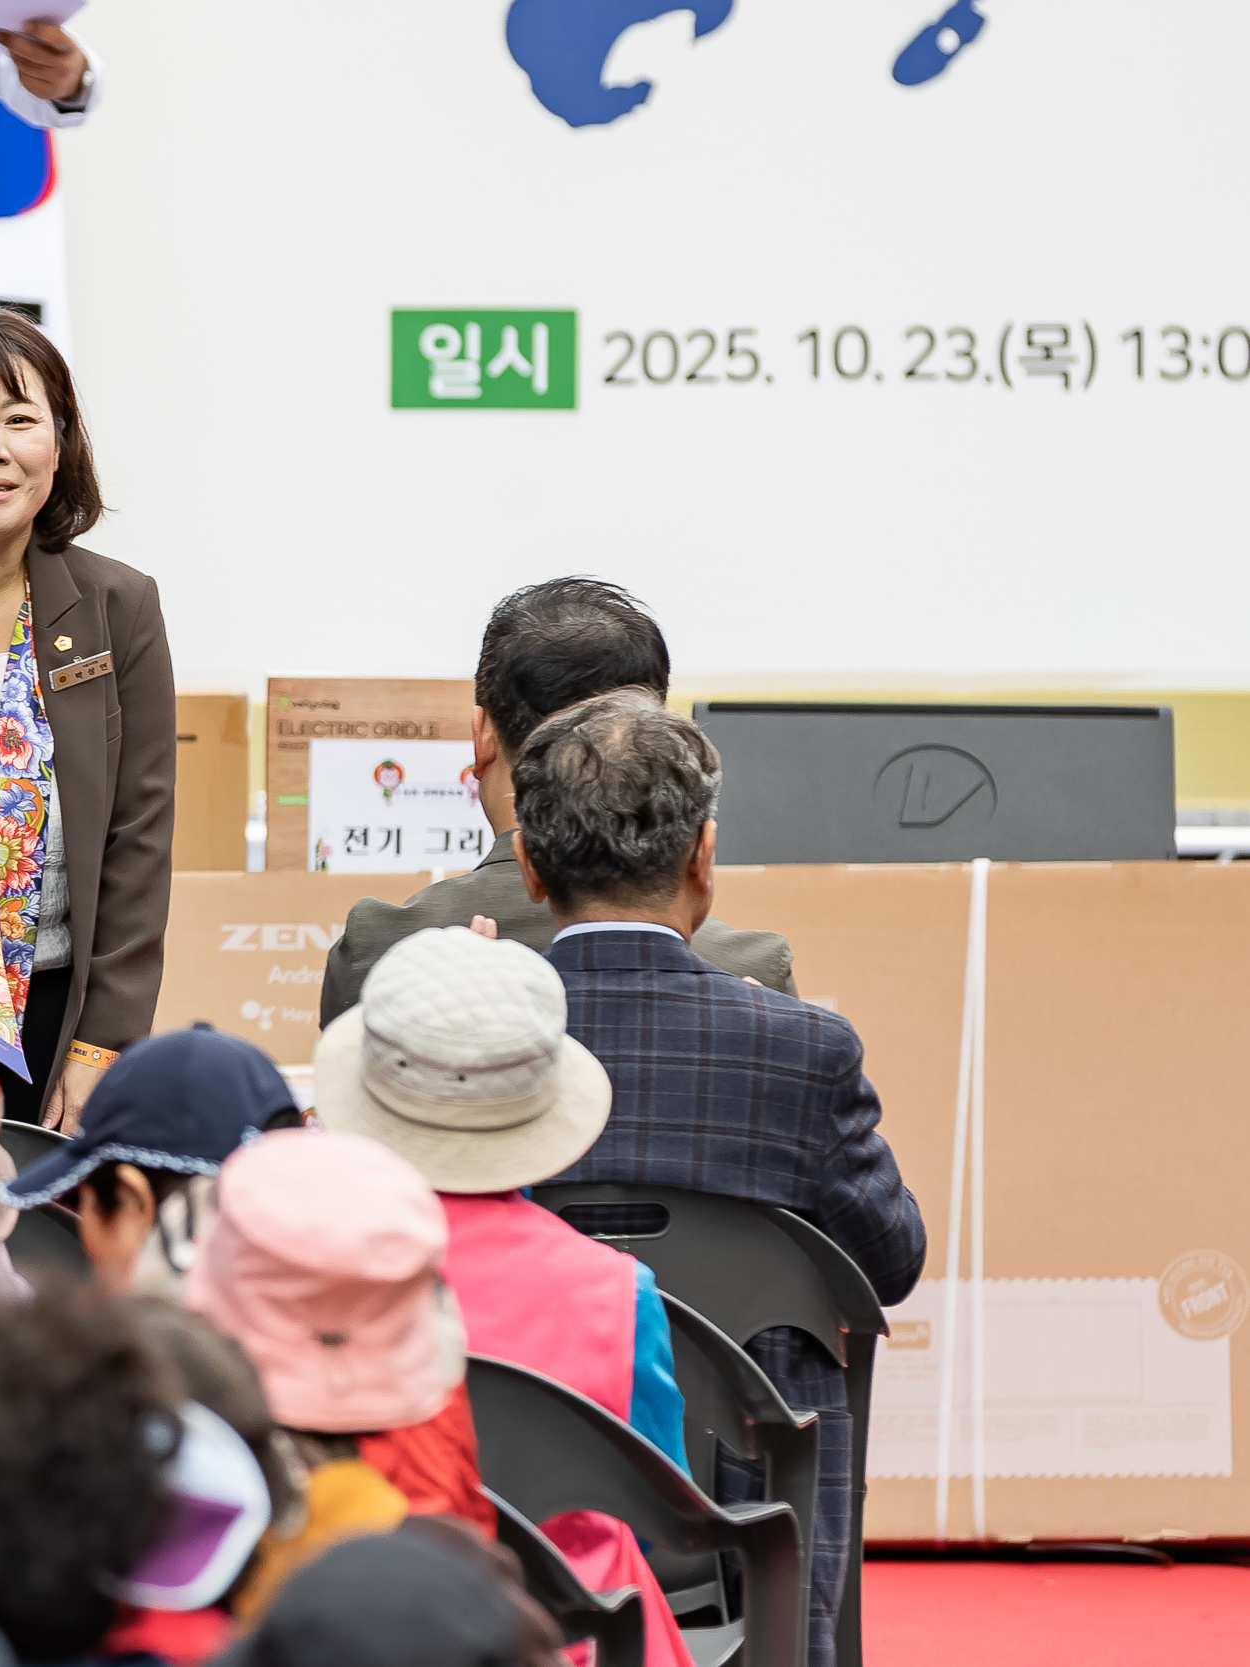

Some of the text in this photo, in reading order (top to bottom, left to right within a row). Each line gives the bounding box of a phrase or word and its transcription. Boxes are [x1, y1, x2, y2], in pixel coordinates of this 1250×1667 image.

[418, 321, 549, 399] 일시
[603, 328, 774, 384] 2025.
[797, 325, 885, 383] 10.
[1120, 325, 1250, 381] 13:0
[277, 719, 368, 738] ELECTRIC
[344, 825, 482, 857] 전기 그리
[219, 923, 347, 951] ZEN
